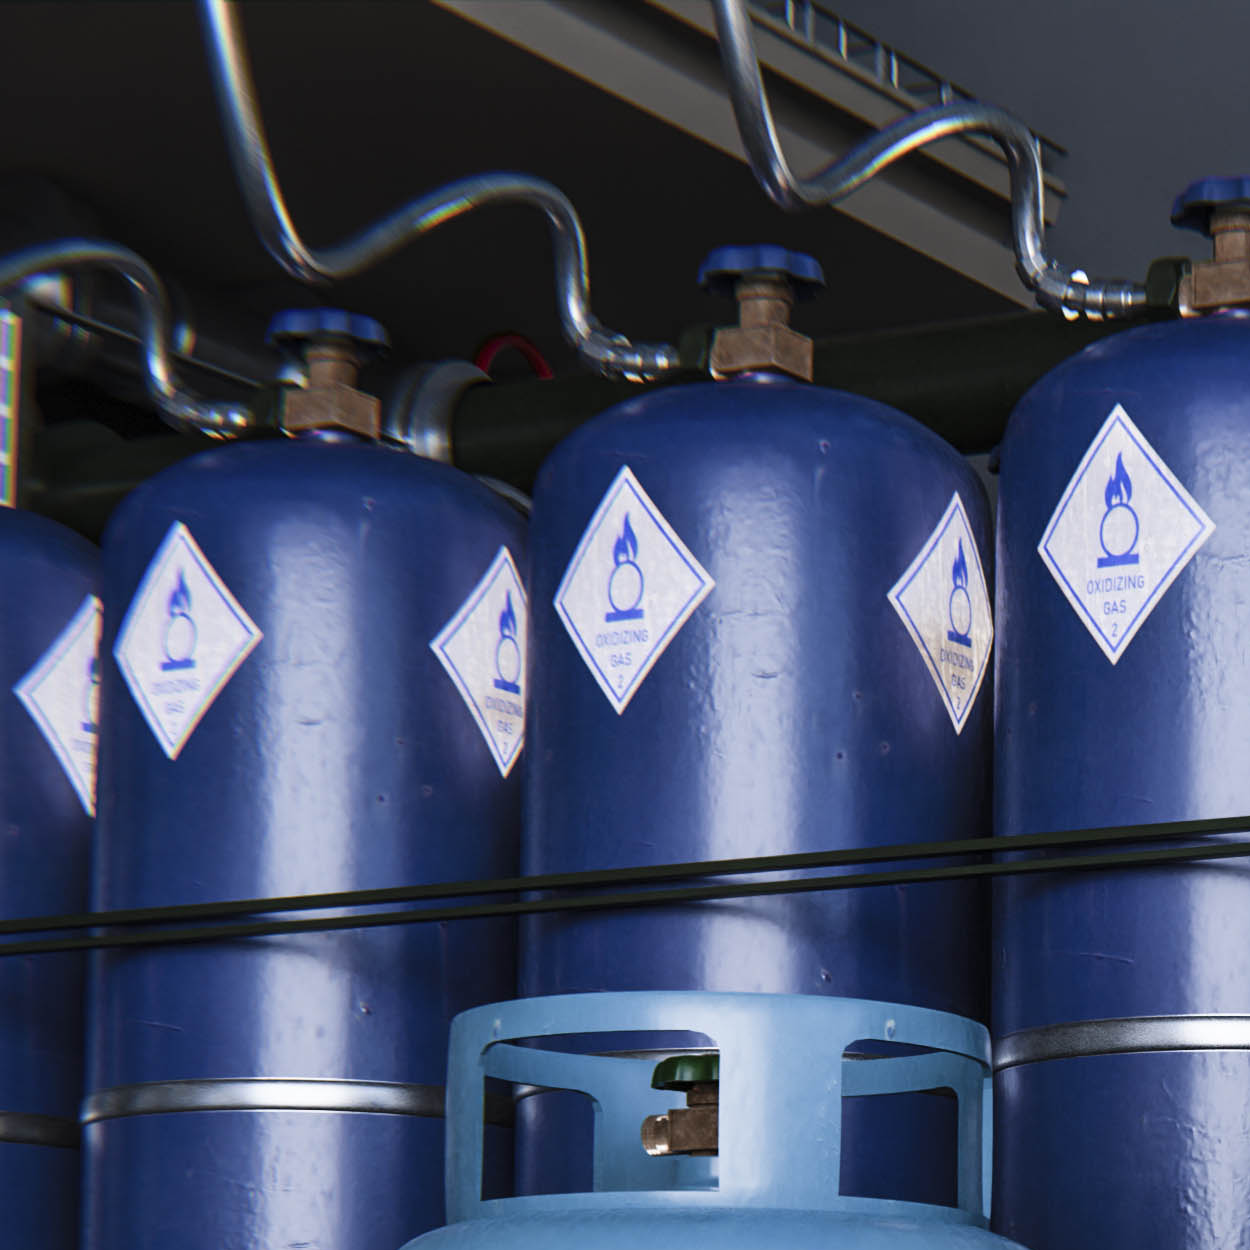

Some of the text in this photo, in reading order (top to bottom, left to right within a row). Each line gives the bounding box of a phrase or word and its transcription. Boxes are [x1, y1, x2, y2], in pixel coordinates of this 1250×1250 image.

[1087, 575, 1145, 595] OXIDIZING
[1103, 600, 1127, 616] GAS
[1112, 622, 1119, 638] 2
[610, 651, 633, 669] GAS
